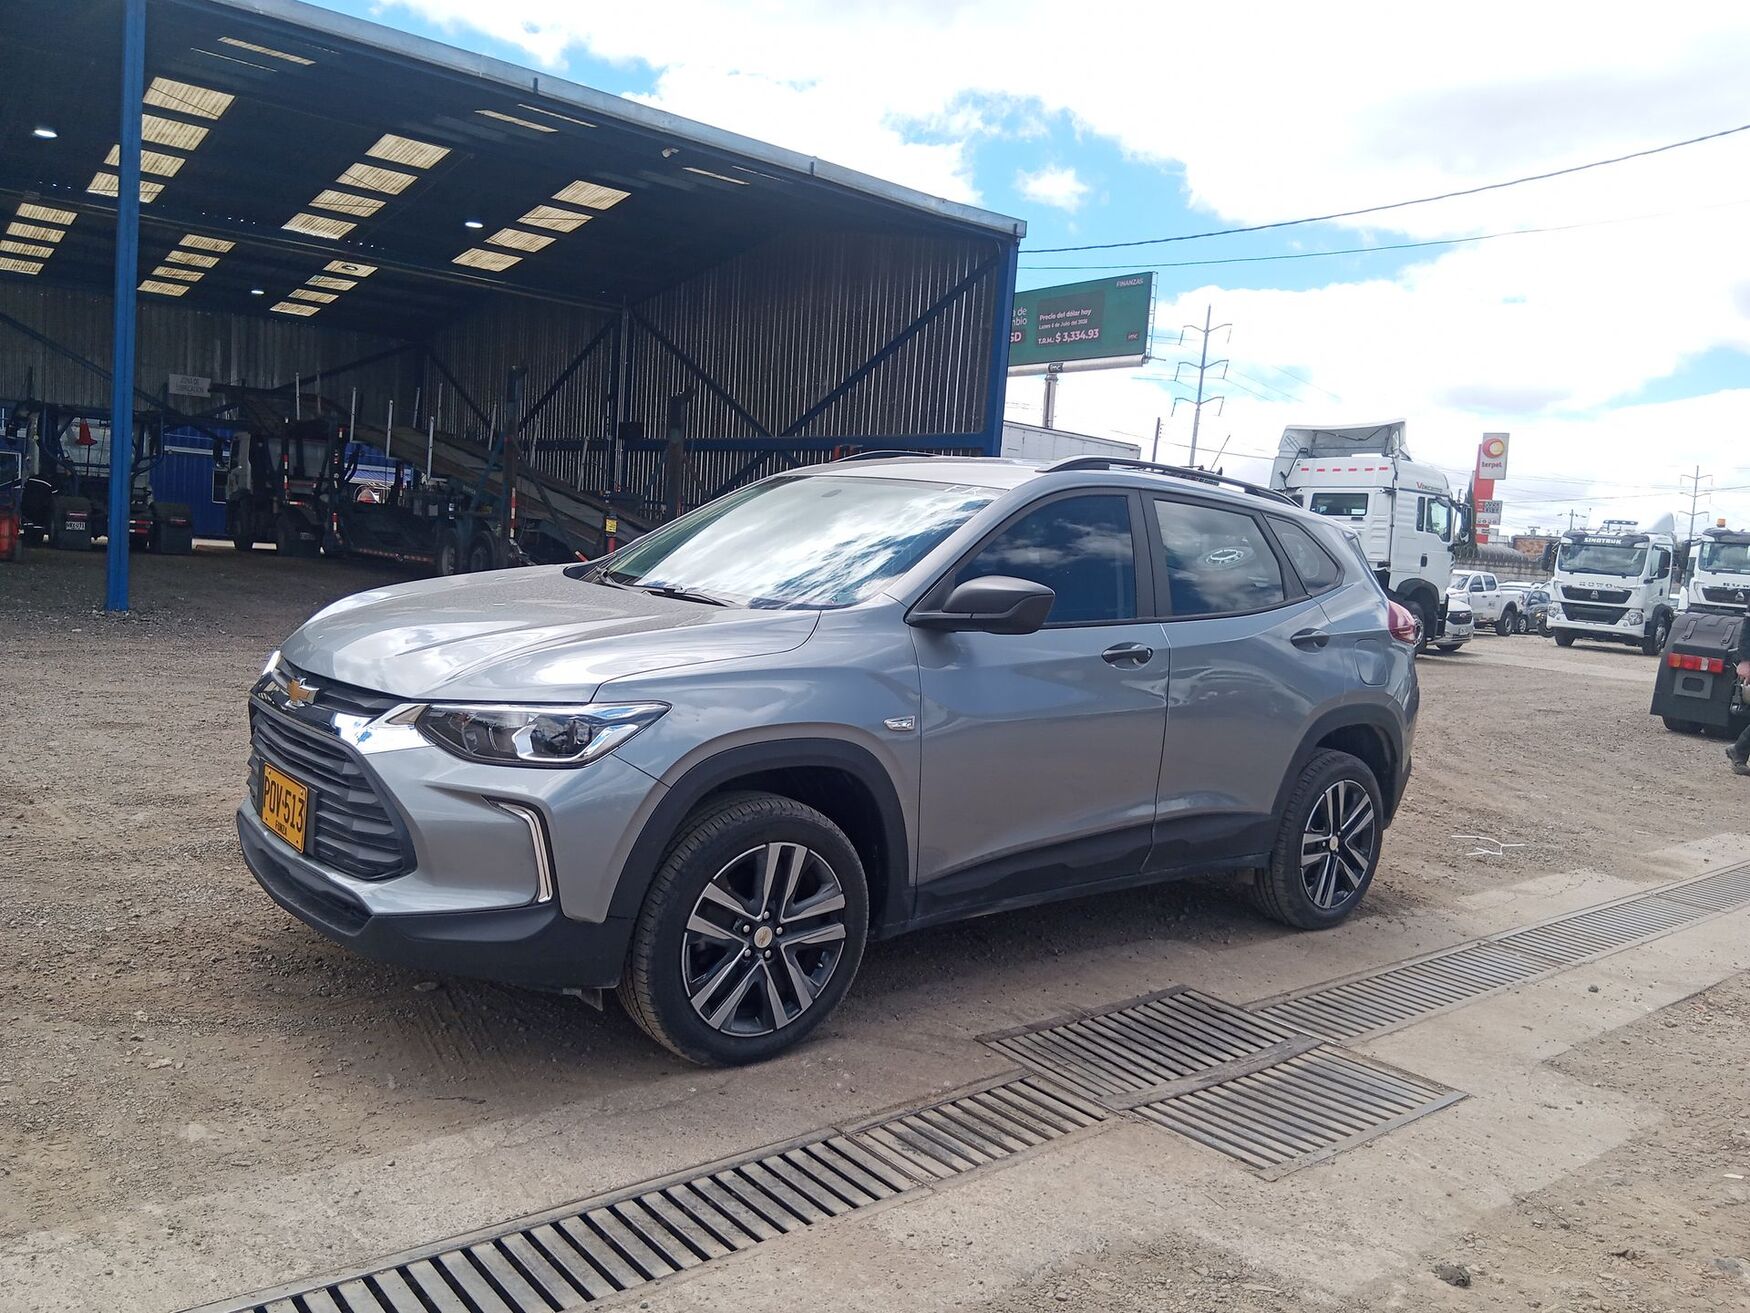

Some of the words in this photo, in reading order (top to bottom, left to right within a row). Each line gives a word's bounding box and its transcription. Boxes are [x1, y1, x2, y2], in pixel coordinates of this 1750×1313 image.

[1116, 278, 1144, 287] FINANZAS
[1017, 307, 1028, 316] de
[1039, 313, 1056, 321] Precio
[1057, 311, 1066, 319] del
[1081, 308, 1092, 318] hoy
[1583, 537, 1622, 545] SINOTRUK
